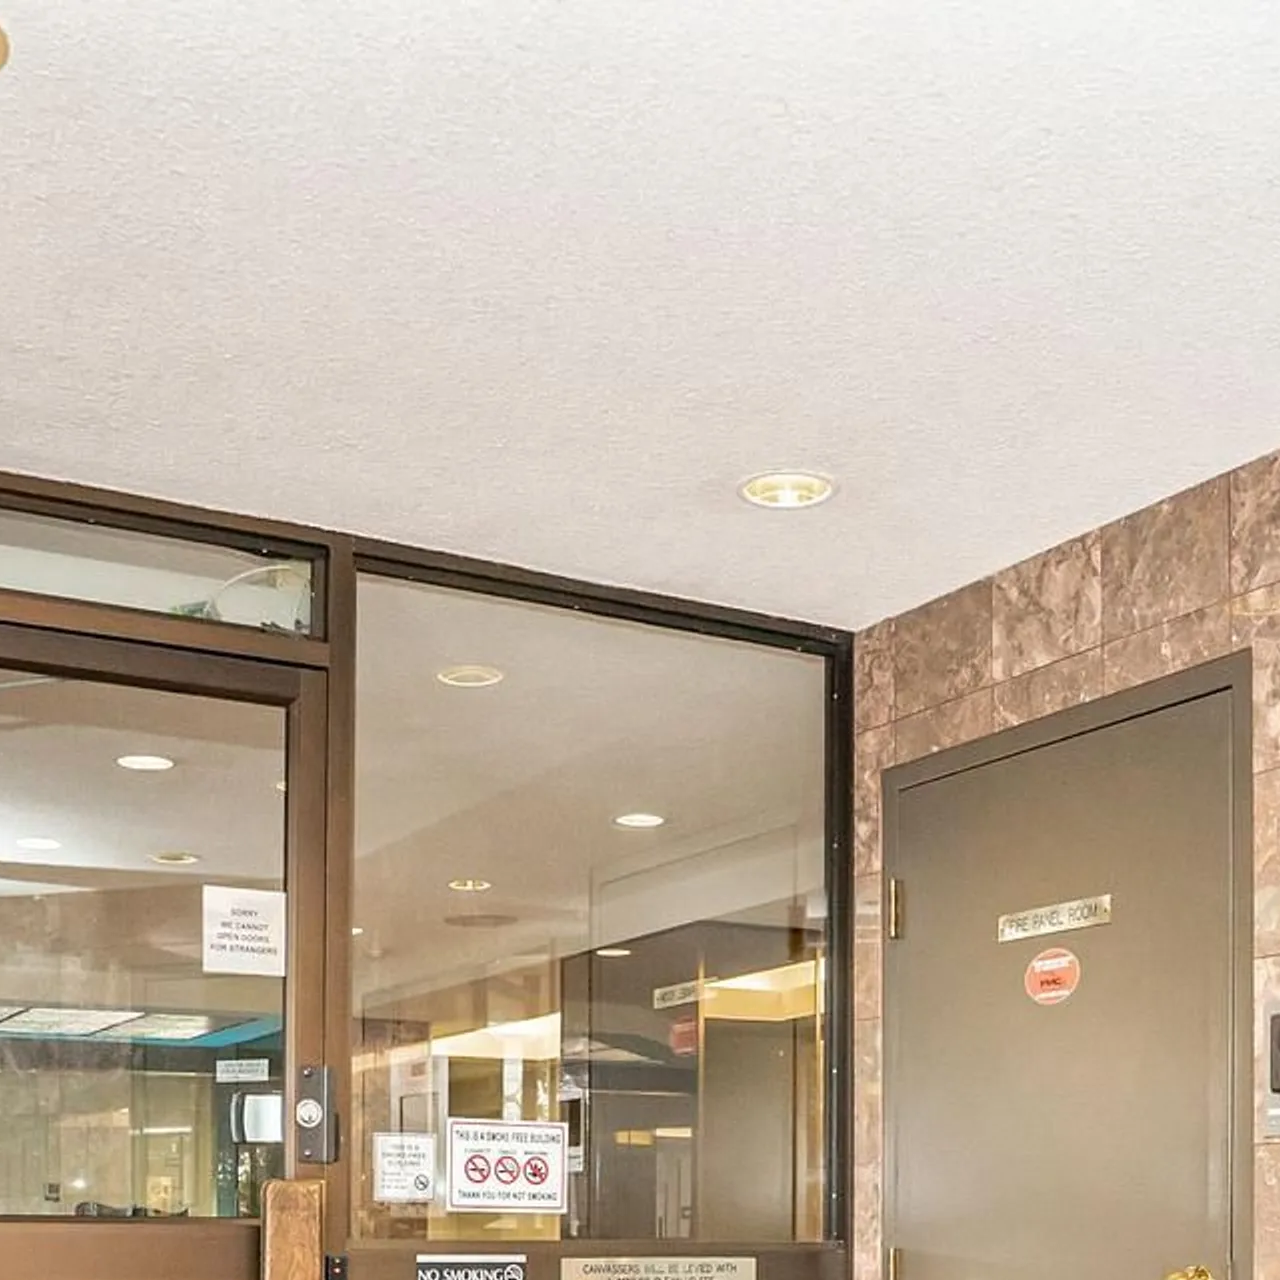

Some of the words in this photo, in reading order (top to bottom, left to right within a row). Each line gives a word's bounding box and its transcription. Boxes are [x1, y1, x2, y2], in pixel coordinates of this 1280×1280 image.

[1032, 910, 1064, 928] PANEL
[1068, 902, 1098, 924] ROOM
[235, 922, 269, 932] CANNOT
[216, 932, 239, 942] OPEN
[240, 934, 269, 944] DOORS
[229, 944, 278, 956] STRANGERS
[511, 1132, 528, 1144] FREE
[530, 1133, 561, 1145] BUILDING
[528, 1191, 558, 1202] SMOKING
[582, 1263, 641, 1275] CANVASSERS
[716, 1262, 738, 1273] WITH
